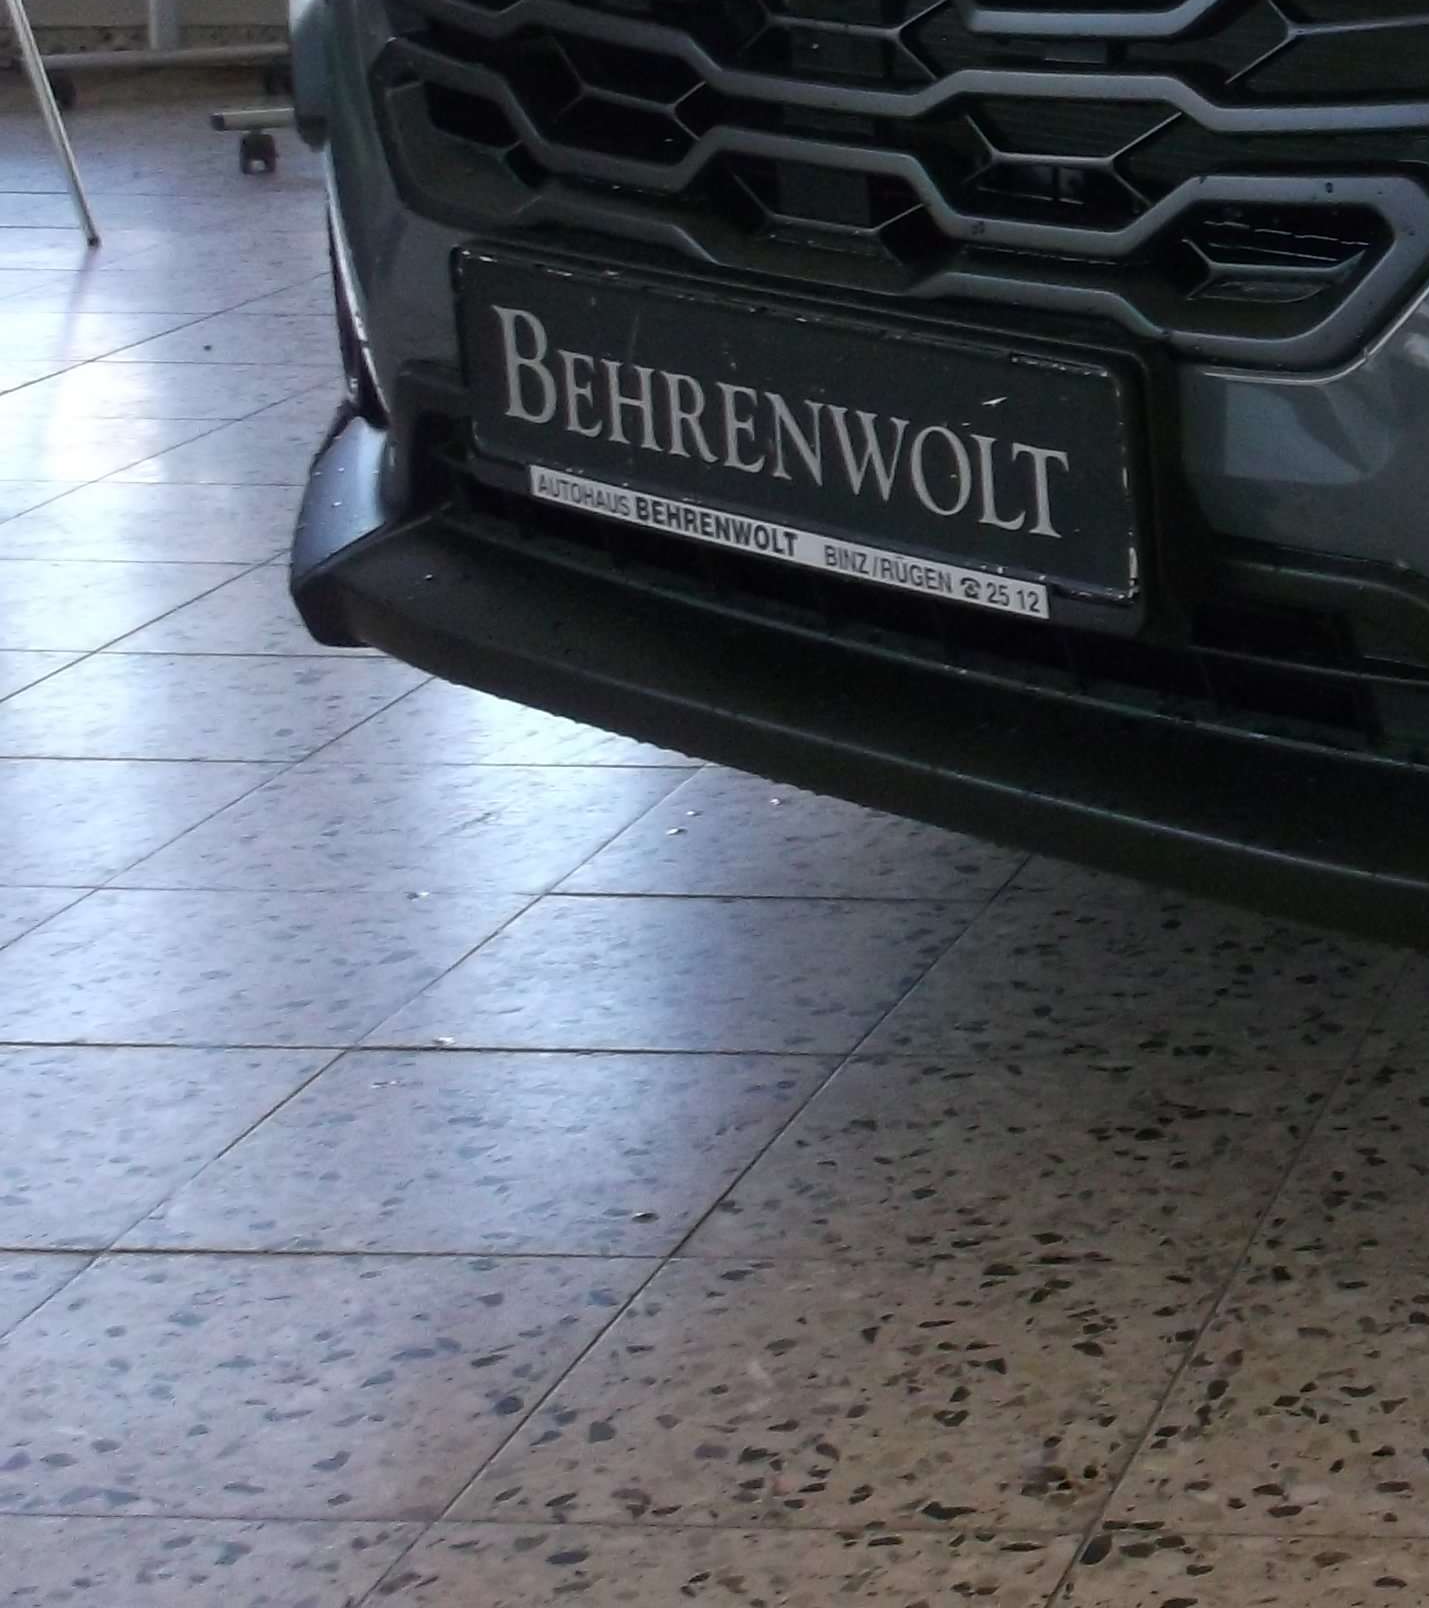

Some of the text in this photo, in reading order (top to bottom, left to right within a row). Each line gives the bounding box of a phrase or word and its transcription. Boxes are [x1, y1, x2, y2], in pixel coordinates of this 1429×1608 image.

[491, 304, 1069, 539] BEHRENWOLT
[538, 474, 630, 517] AUTOHAUS
[634, 496, 799, 557] BEHRENWOLT
[986, 582, 1010, 608] 25
[1016, 589, 1041, 613] 12
